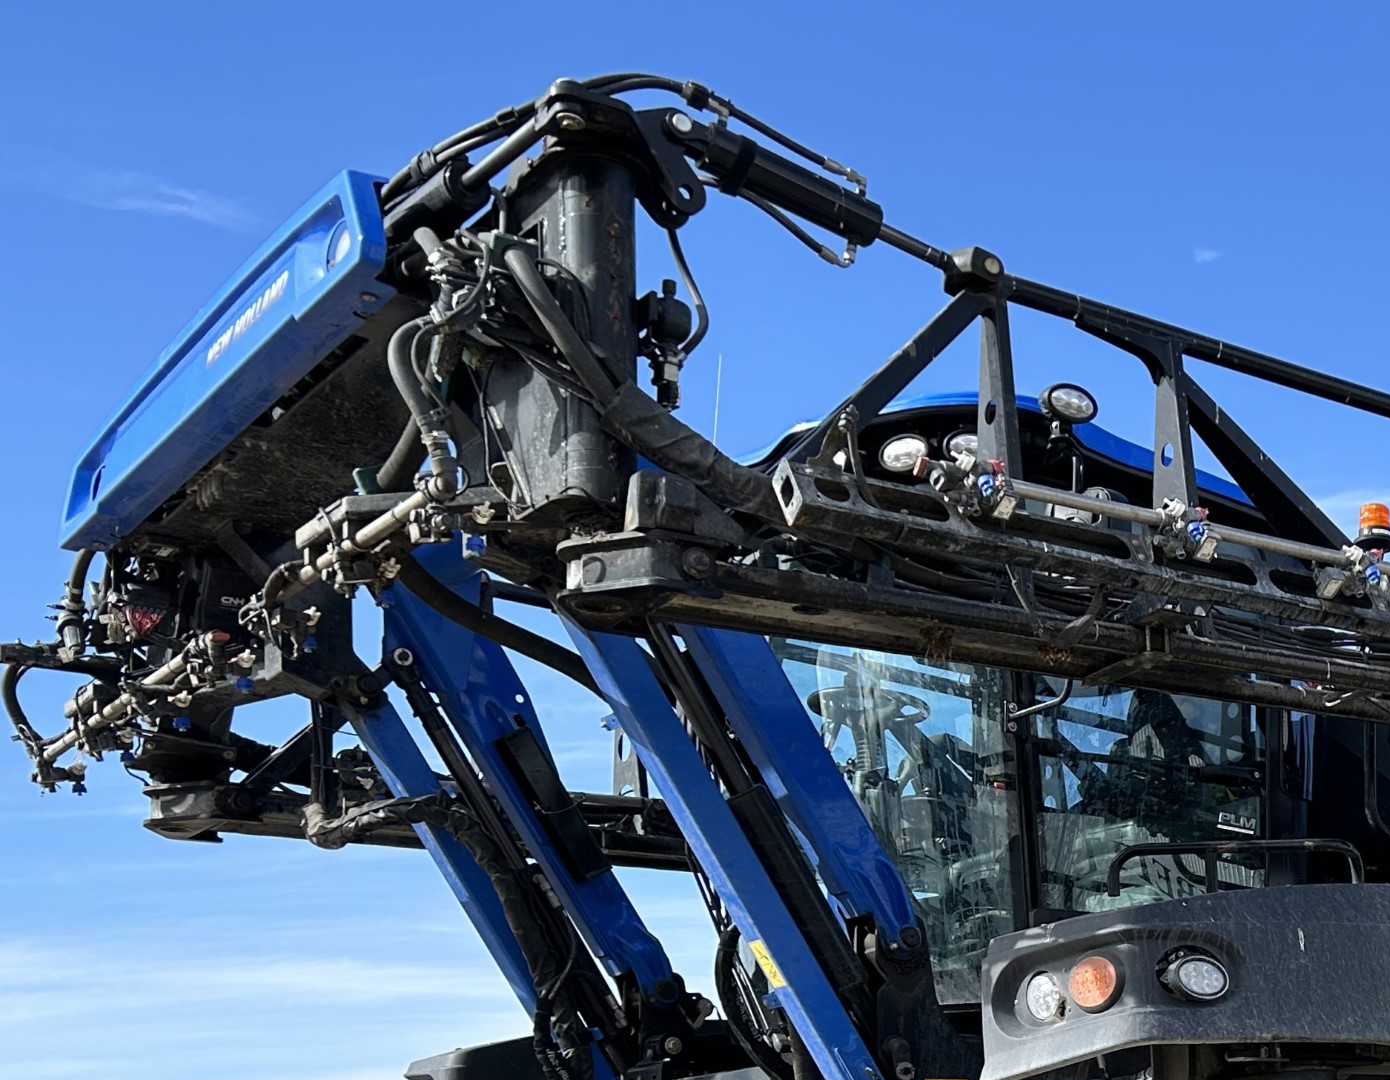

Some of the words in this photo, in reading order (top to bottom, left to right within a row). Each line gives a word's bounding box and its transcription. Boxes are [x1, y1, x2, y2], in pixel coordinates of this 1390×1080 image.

[206, 326, 234, 366] NEW
[234, 270, 289, 339] HOLLAND
[1218, 812, 1256, 829] PLM
